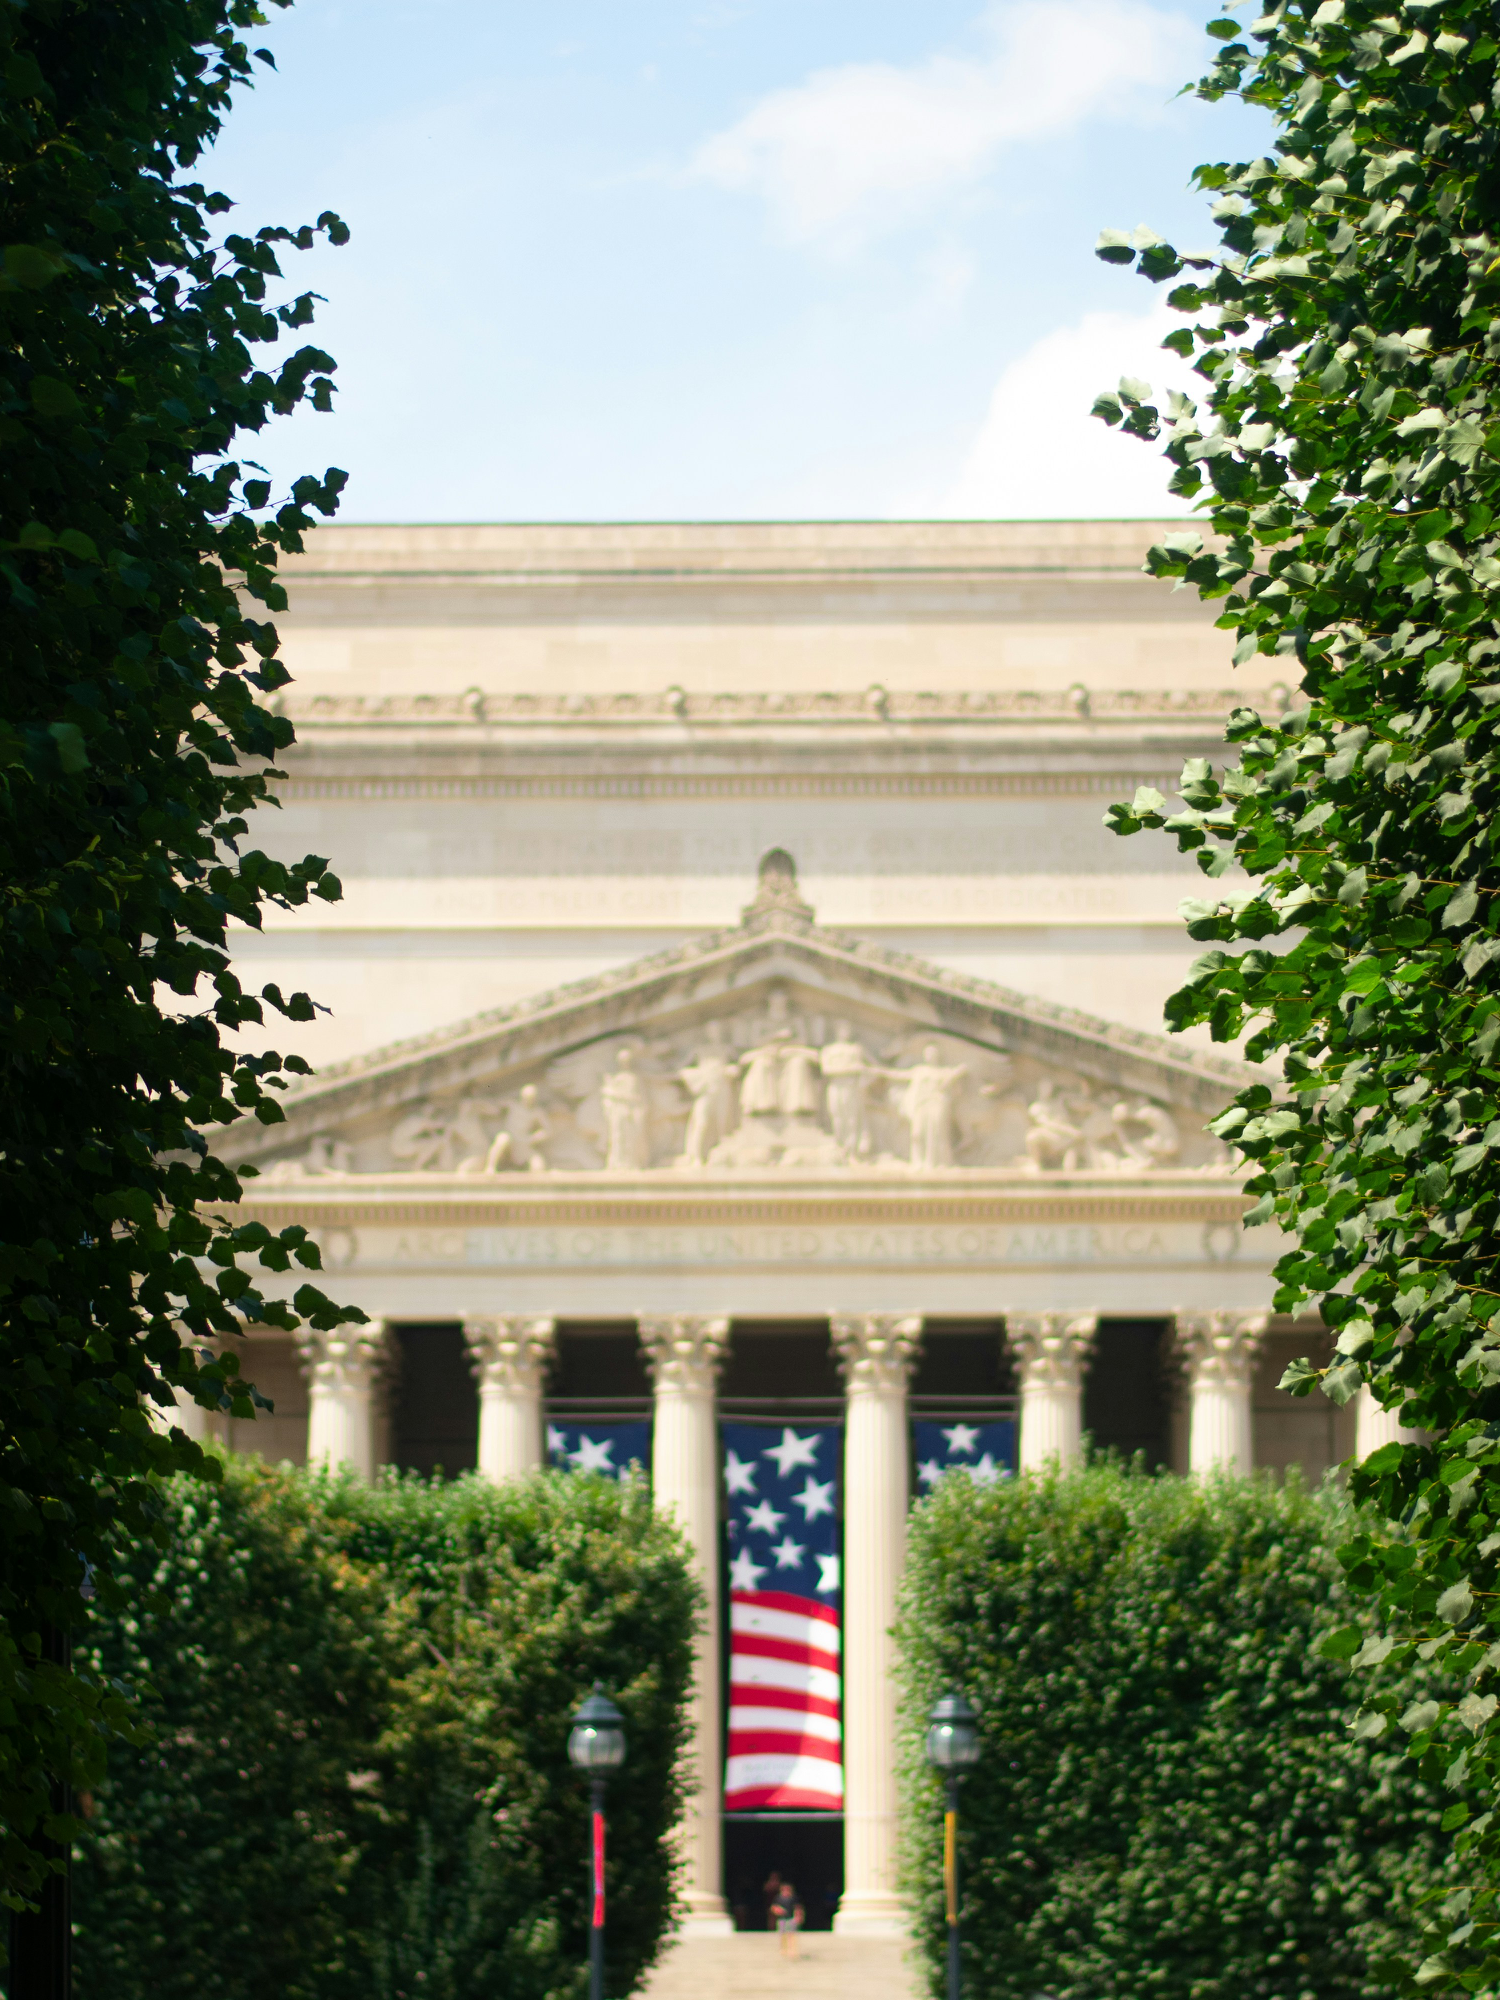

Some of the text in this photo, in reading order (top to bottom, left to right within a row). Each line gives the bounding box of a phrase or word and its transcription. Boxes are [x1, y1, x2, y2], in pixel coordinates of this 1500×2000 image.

[393, 1229, 1169, 1261] ARCHIVES OF THE UNITED STATES OF AMERICA
